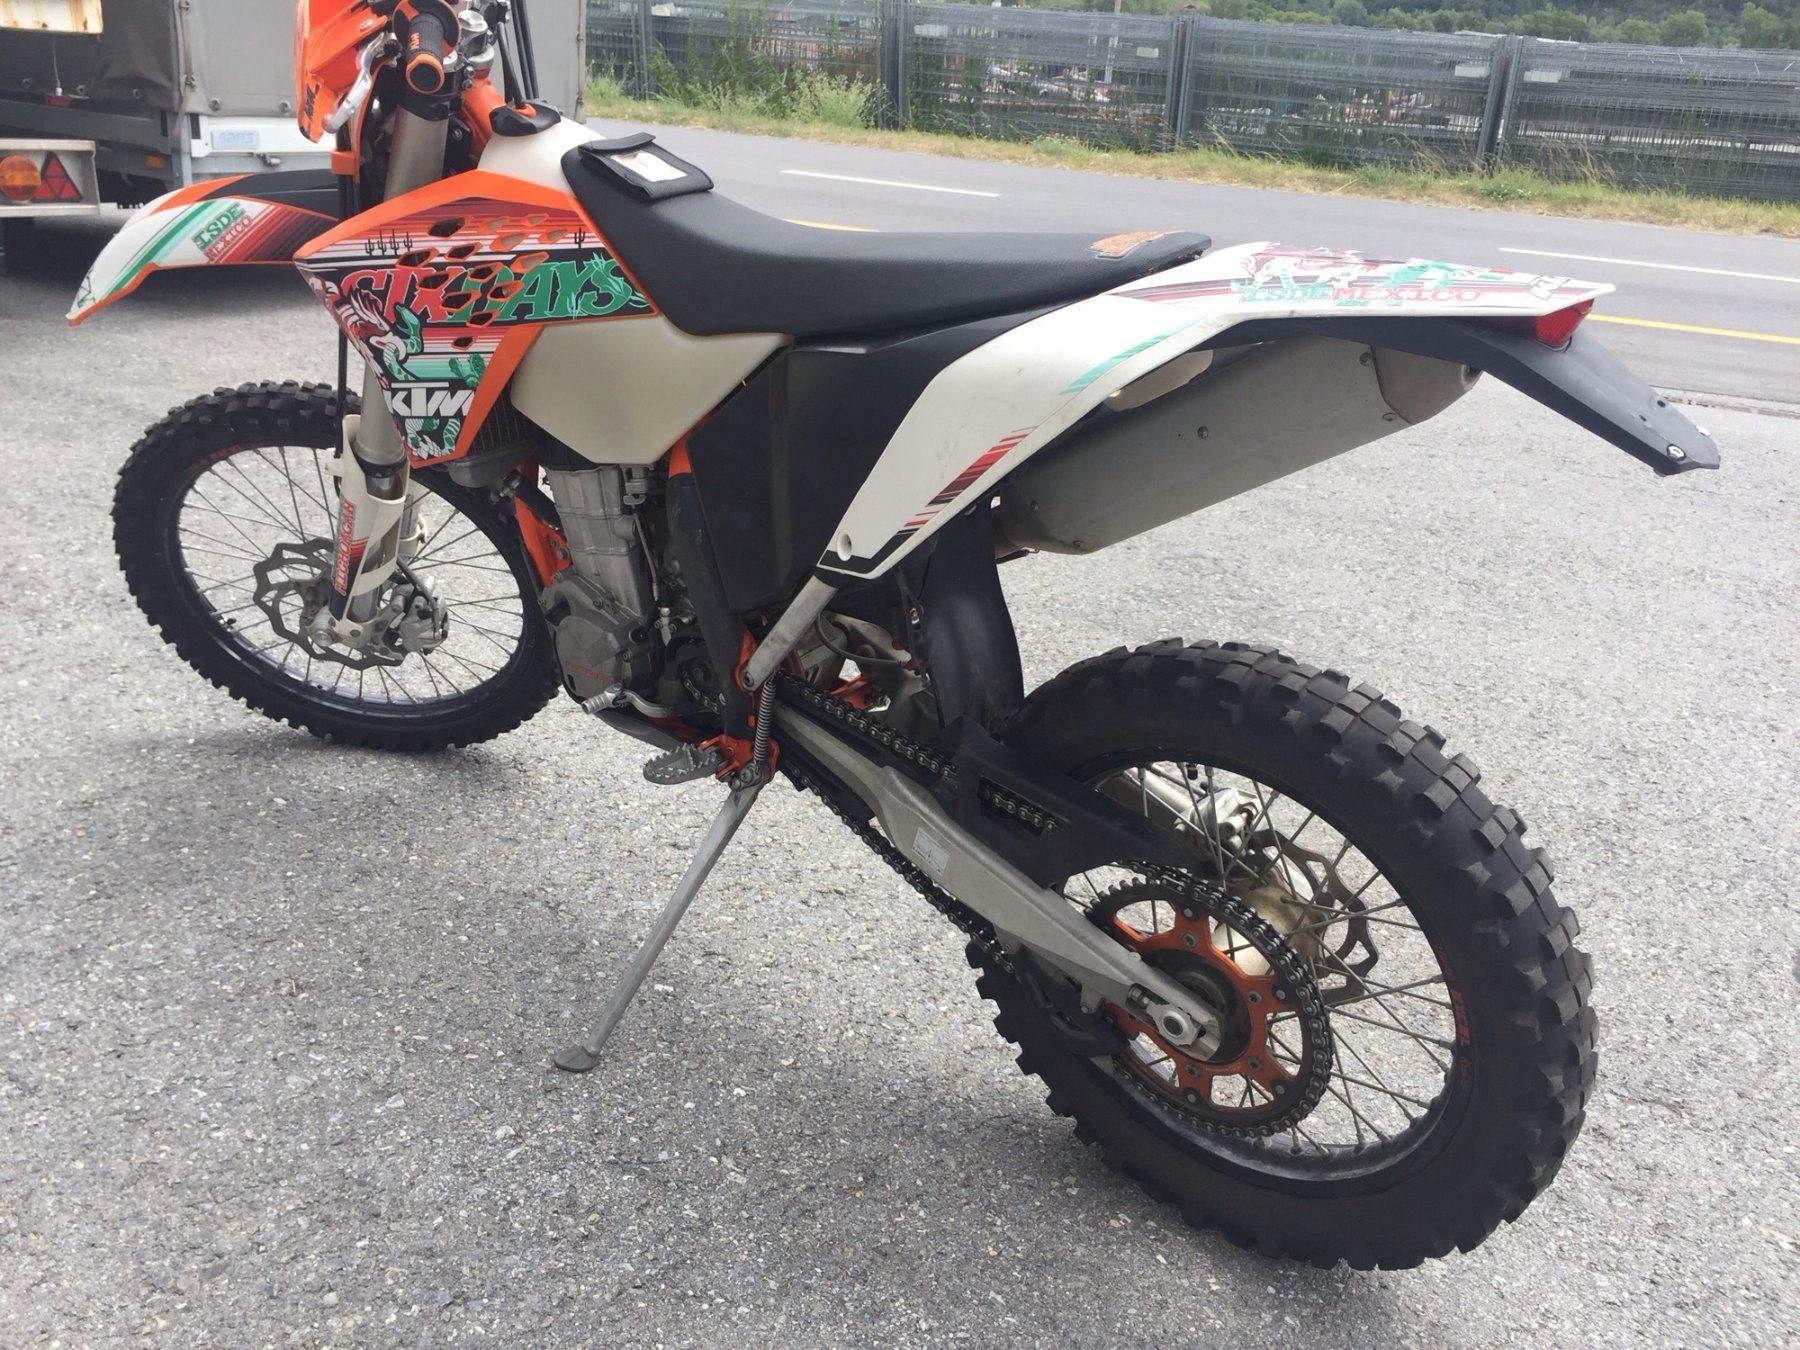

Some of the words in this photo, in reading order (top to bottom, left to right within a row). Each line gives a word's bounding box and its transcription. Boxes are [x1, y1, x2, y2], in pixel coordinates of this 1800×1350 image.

[192, 201, 247, 252] ISDE
[204, 214, 251, 262] MEXICO
[1330, 286, 1484, 302] MEXICO
[383, 381, 475, 417] KTM
